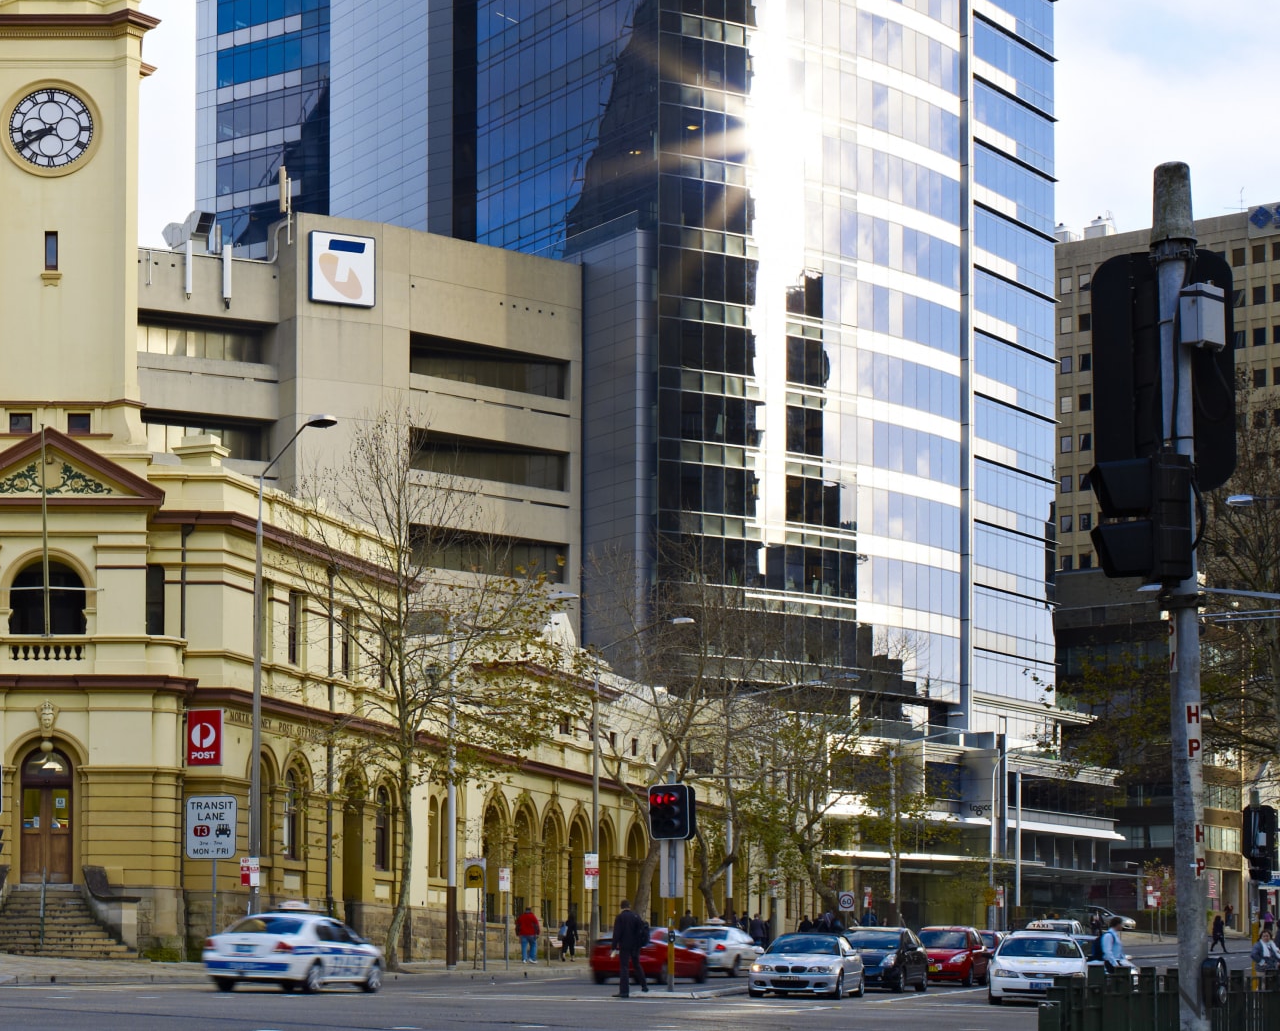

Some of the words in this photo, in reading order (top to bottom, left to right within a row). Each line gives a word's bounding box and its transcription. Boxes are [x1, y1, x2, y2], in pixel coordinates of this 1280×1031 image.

[229, 710, 250, 724] NORTH
[278, 721, 295, 733] POST
[191, 751, 216, 760] POST
[190, 801, 234, 810] TRANSIT
[197, 812, 225, 821] LANE
[195, 826, 208, 836] T3
[216, 847, 229, 855] FRI
[841, 897, 852, 906] 60
